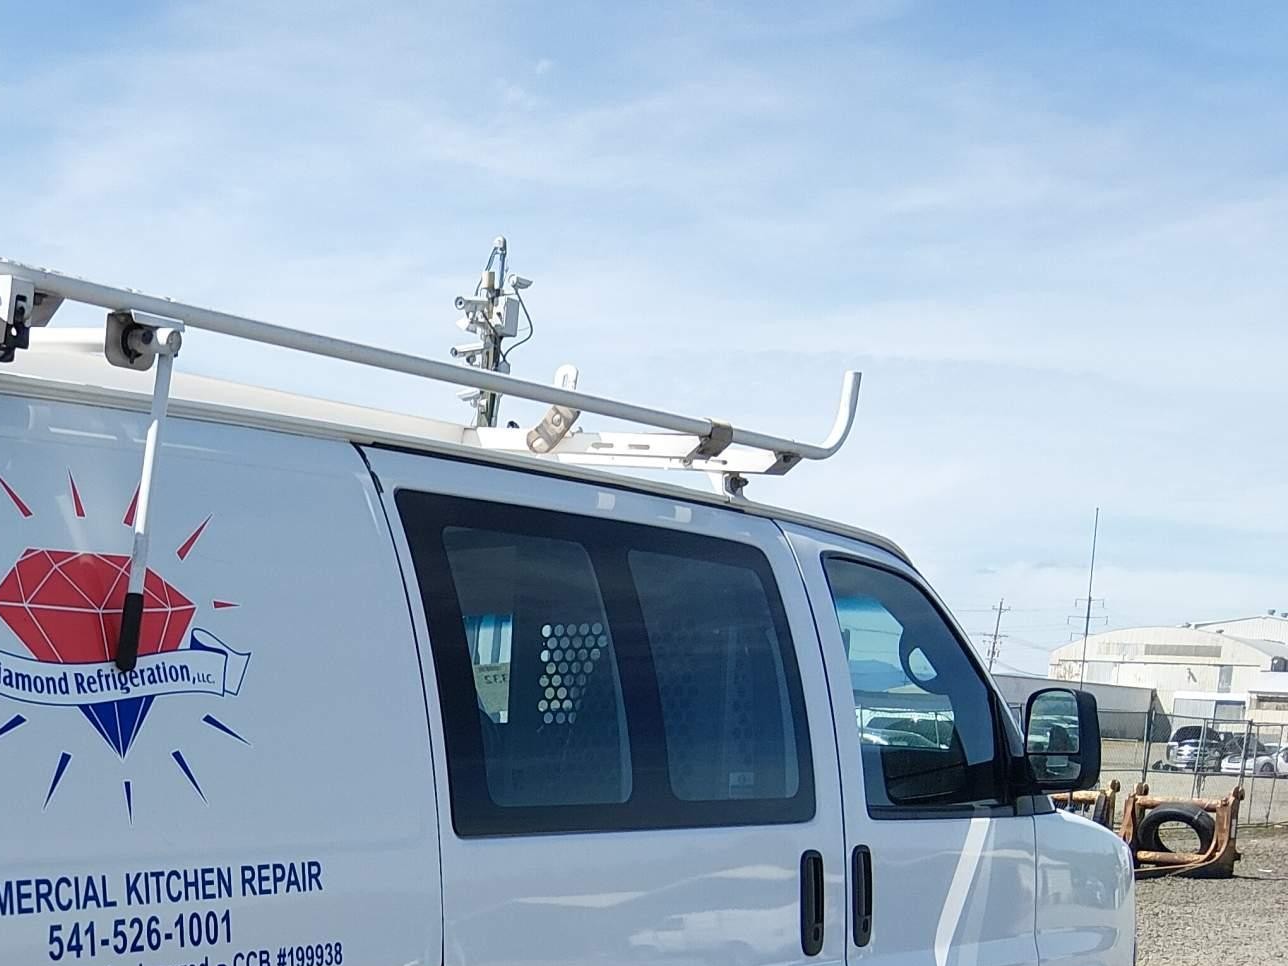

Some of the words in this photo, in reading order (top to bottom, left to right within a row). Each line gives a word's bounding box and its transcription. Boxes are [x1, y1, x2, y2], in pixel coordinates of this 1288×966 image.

[74, 663, 196, 694] Refrigeration,
[125, 866, 233, 906] KITCHEN
[241, 860, 324, 895] REPAIR
[49, 909, 233, 961] 541-526-1001
